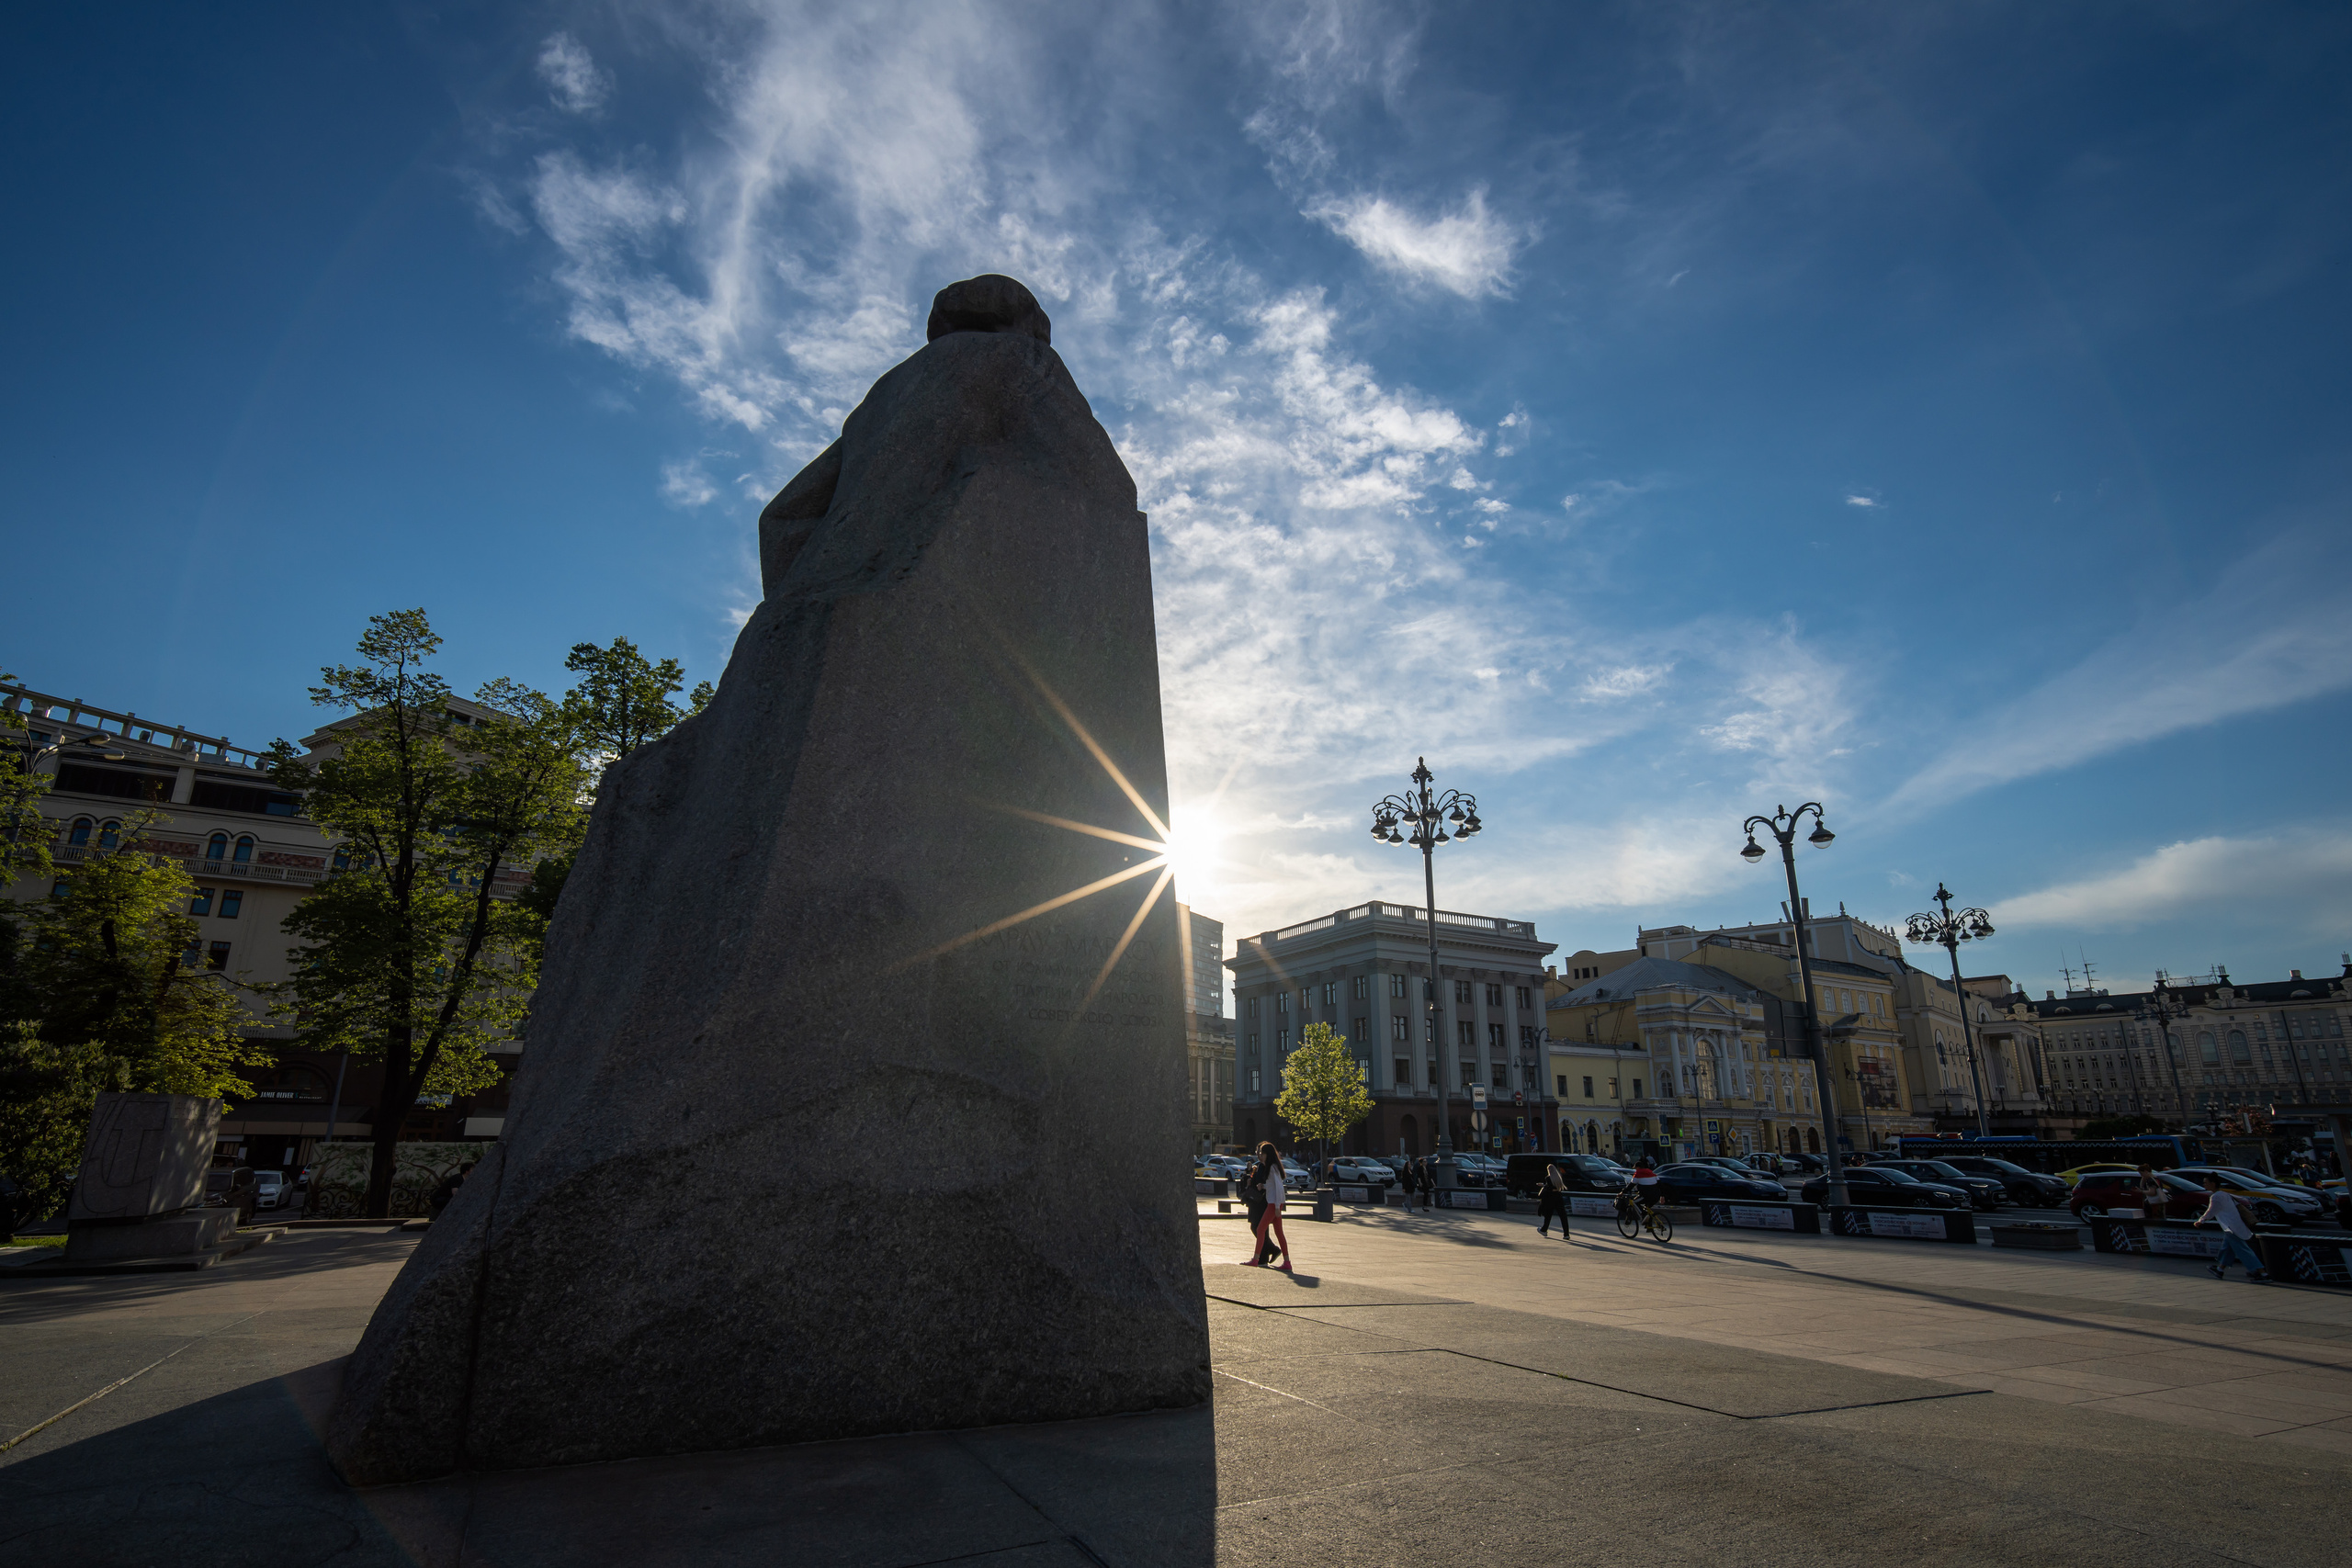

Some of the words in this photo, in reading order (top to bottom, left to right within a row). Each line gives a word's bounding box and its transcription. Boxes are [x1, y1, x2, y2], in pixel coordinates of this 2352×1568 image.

[1017, 961, 1164, 983] КОММУНИСИЧЕСКОЙ
[1028, 1008, 1114, 1026] СОВЕТСКОГО
[1711, 1134, 1718, 1143] P
[2153, 1234, 2199, 1242] МОСКОВСКИЕ
